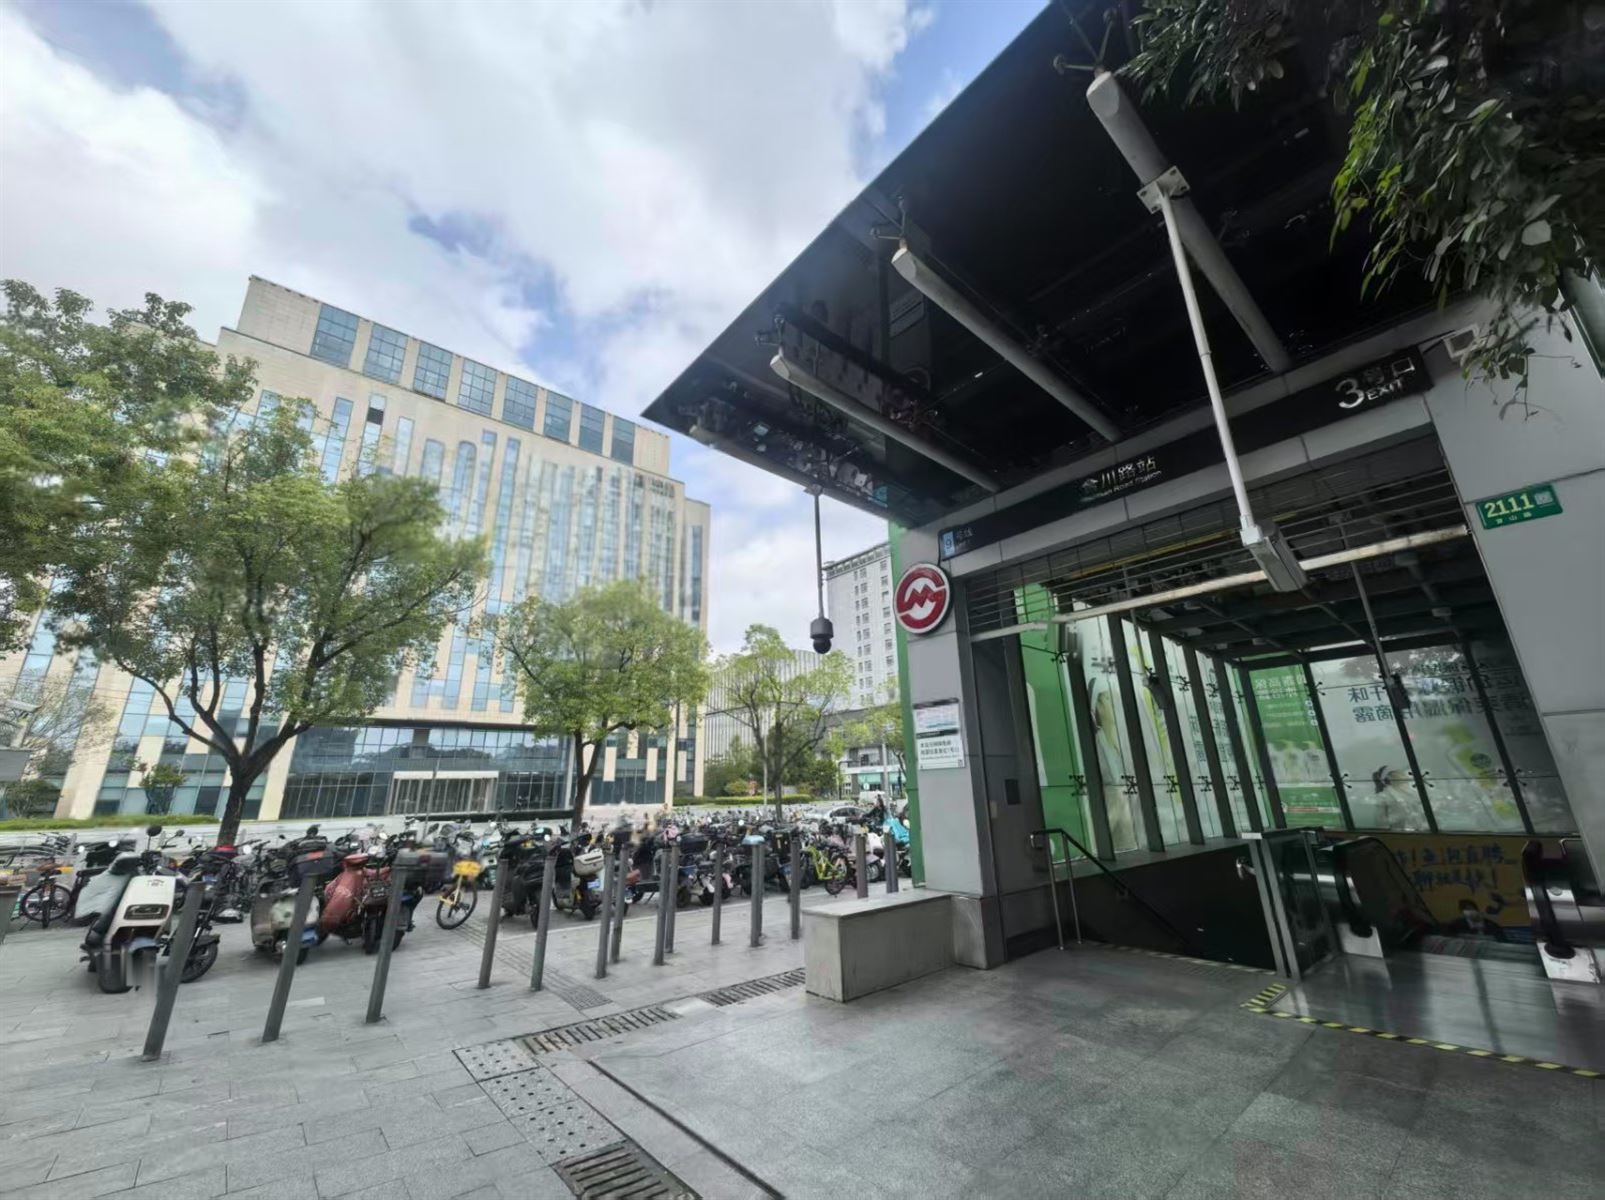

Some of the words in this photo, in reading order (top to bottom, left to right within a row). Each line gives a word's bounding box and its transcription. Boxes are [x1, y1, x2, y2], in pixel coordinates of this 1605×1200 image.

[1336, 378, 1365, 409] 3
[1366, 379, 1403, 401] EXIT
[1484, 493, 1535, 519] 2111
